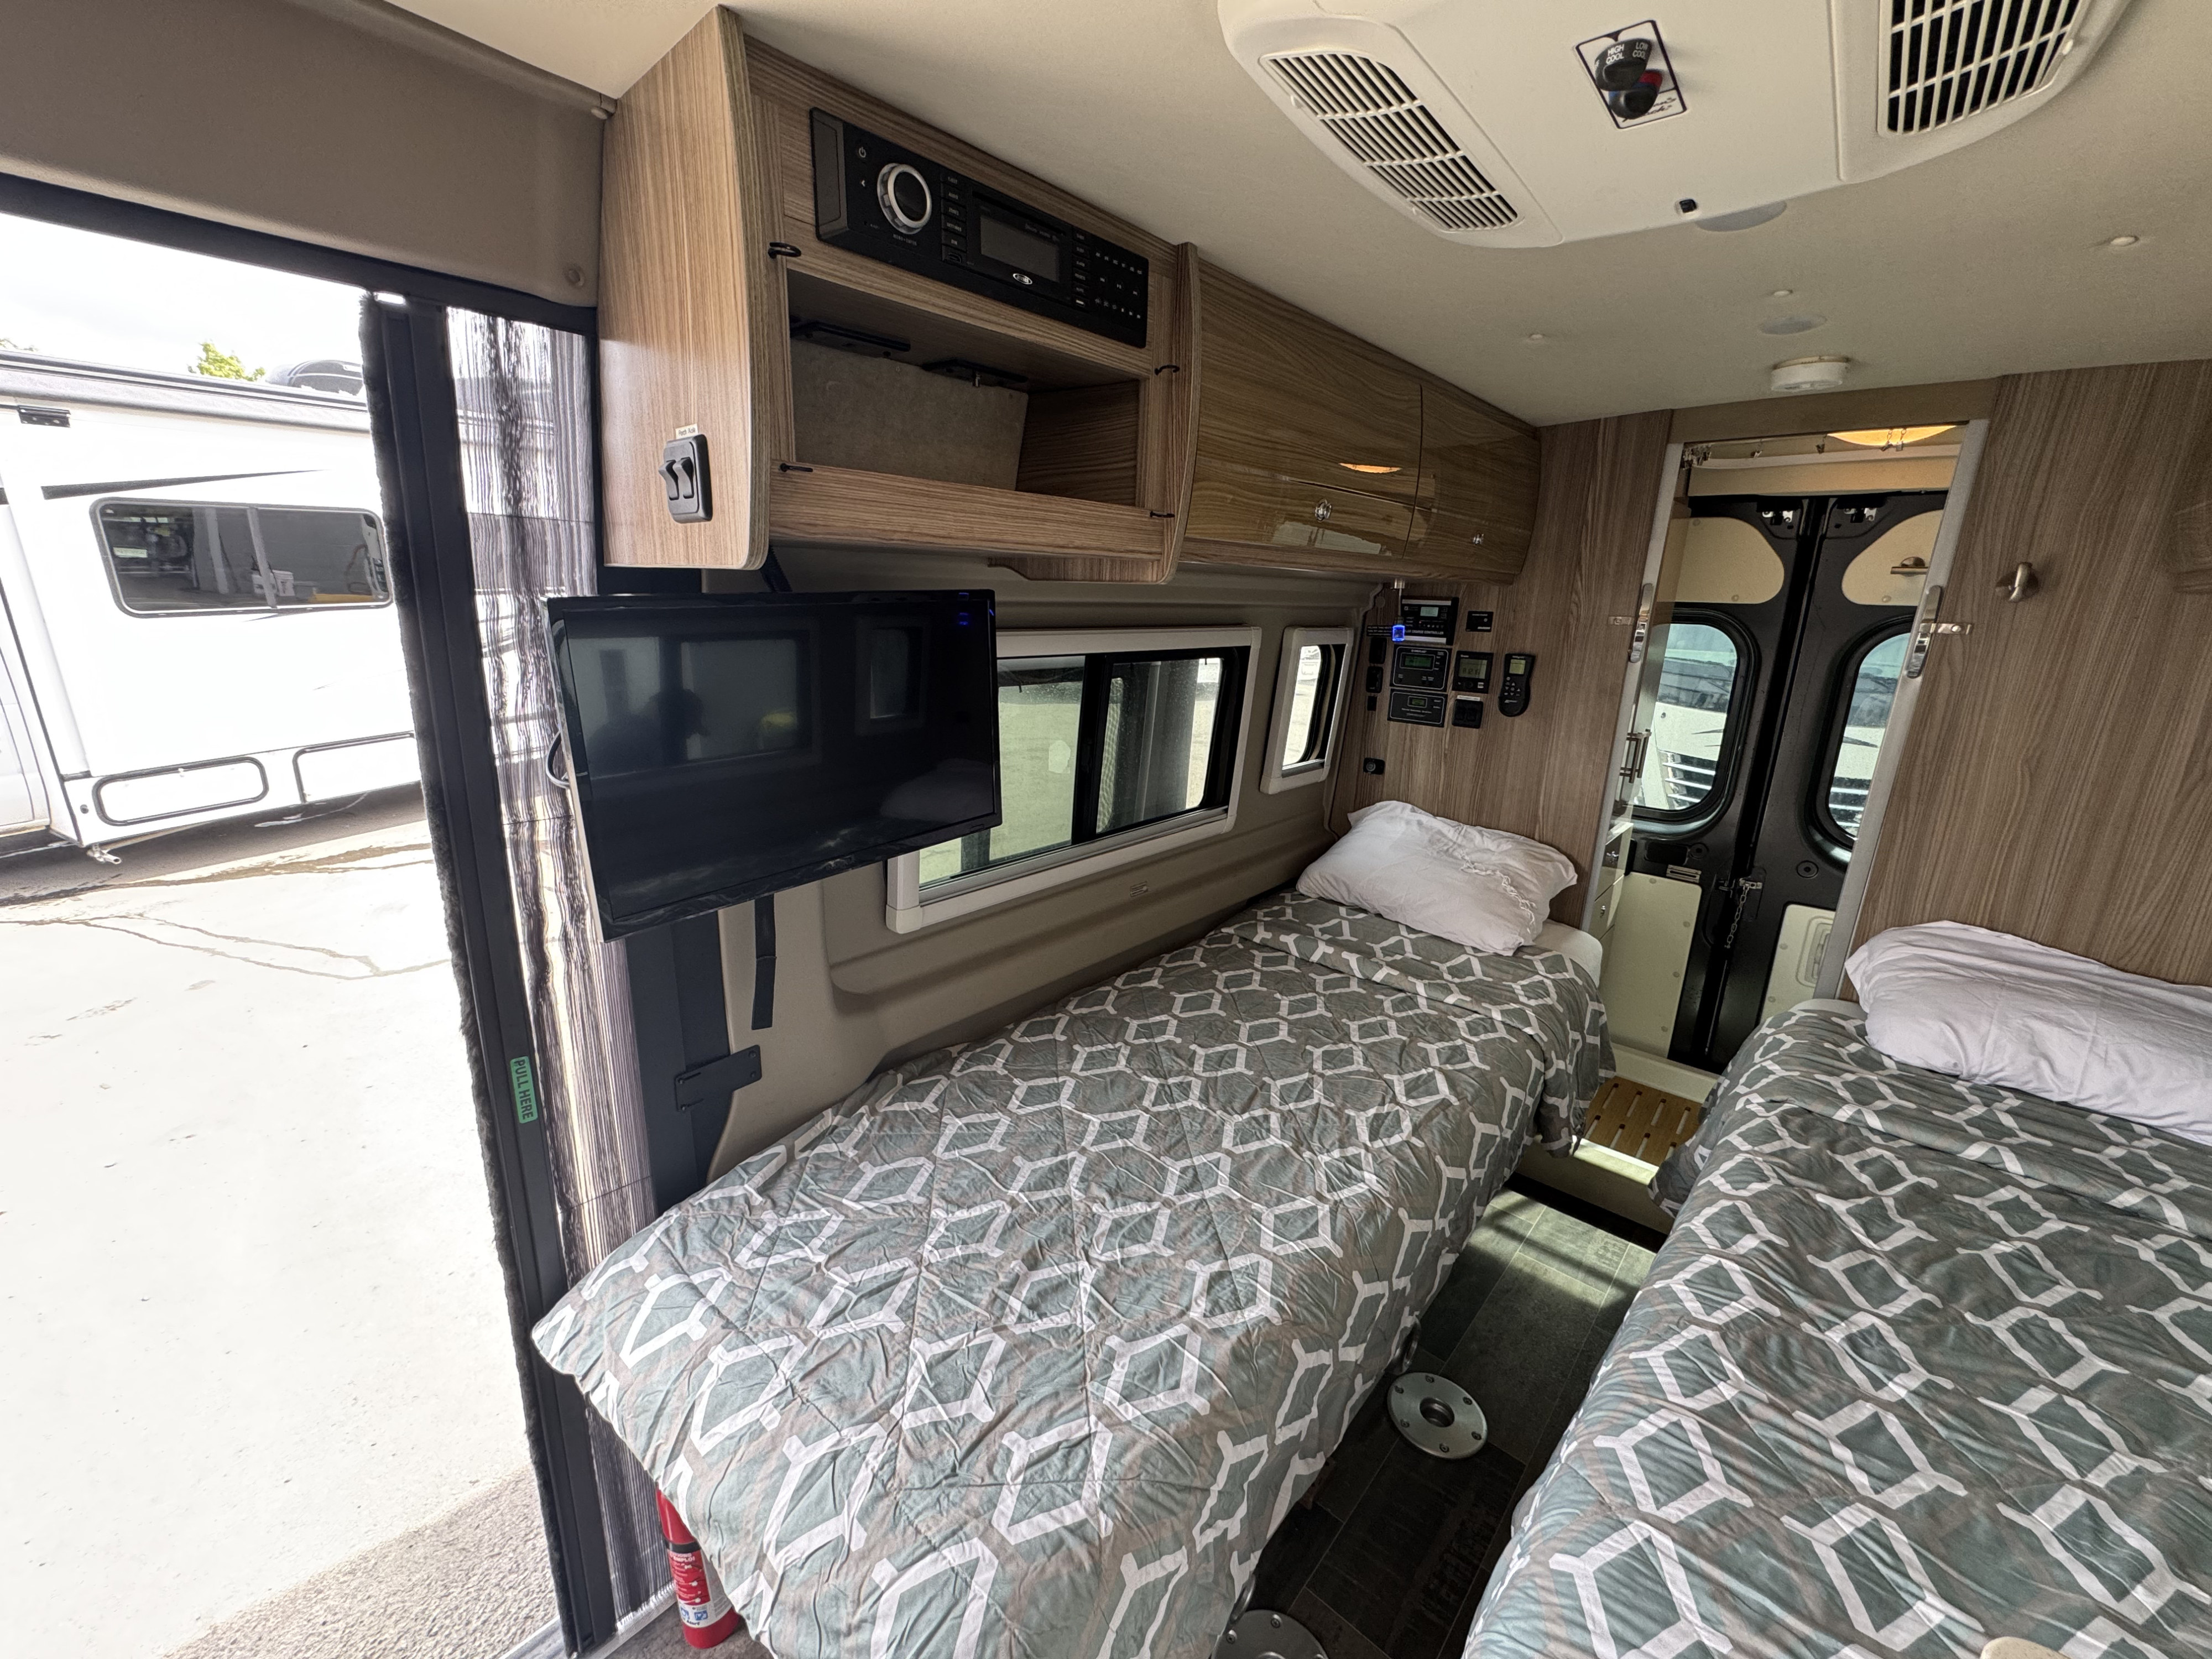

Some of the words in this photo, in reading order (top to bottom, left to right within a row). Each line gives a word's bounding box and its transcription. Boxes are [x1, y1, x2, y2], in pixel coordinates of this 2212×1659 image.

[1608, 44, 1624, 56] HIGH
[1635, 41, 1648, 50] LOW
[1606, 53, 1624, 64] COOL
[513, 1059, 529, 1089] PULL
[518, 1089, 534, 1120] HERE
